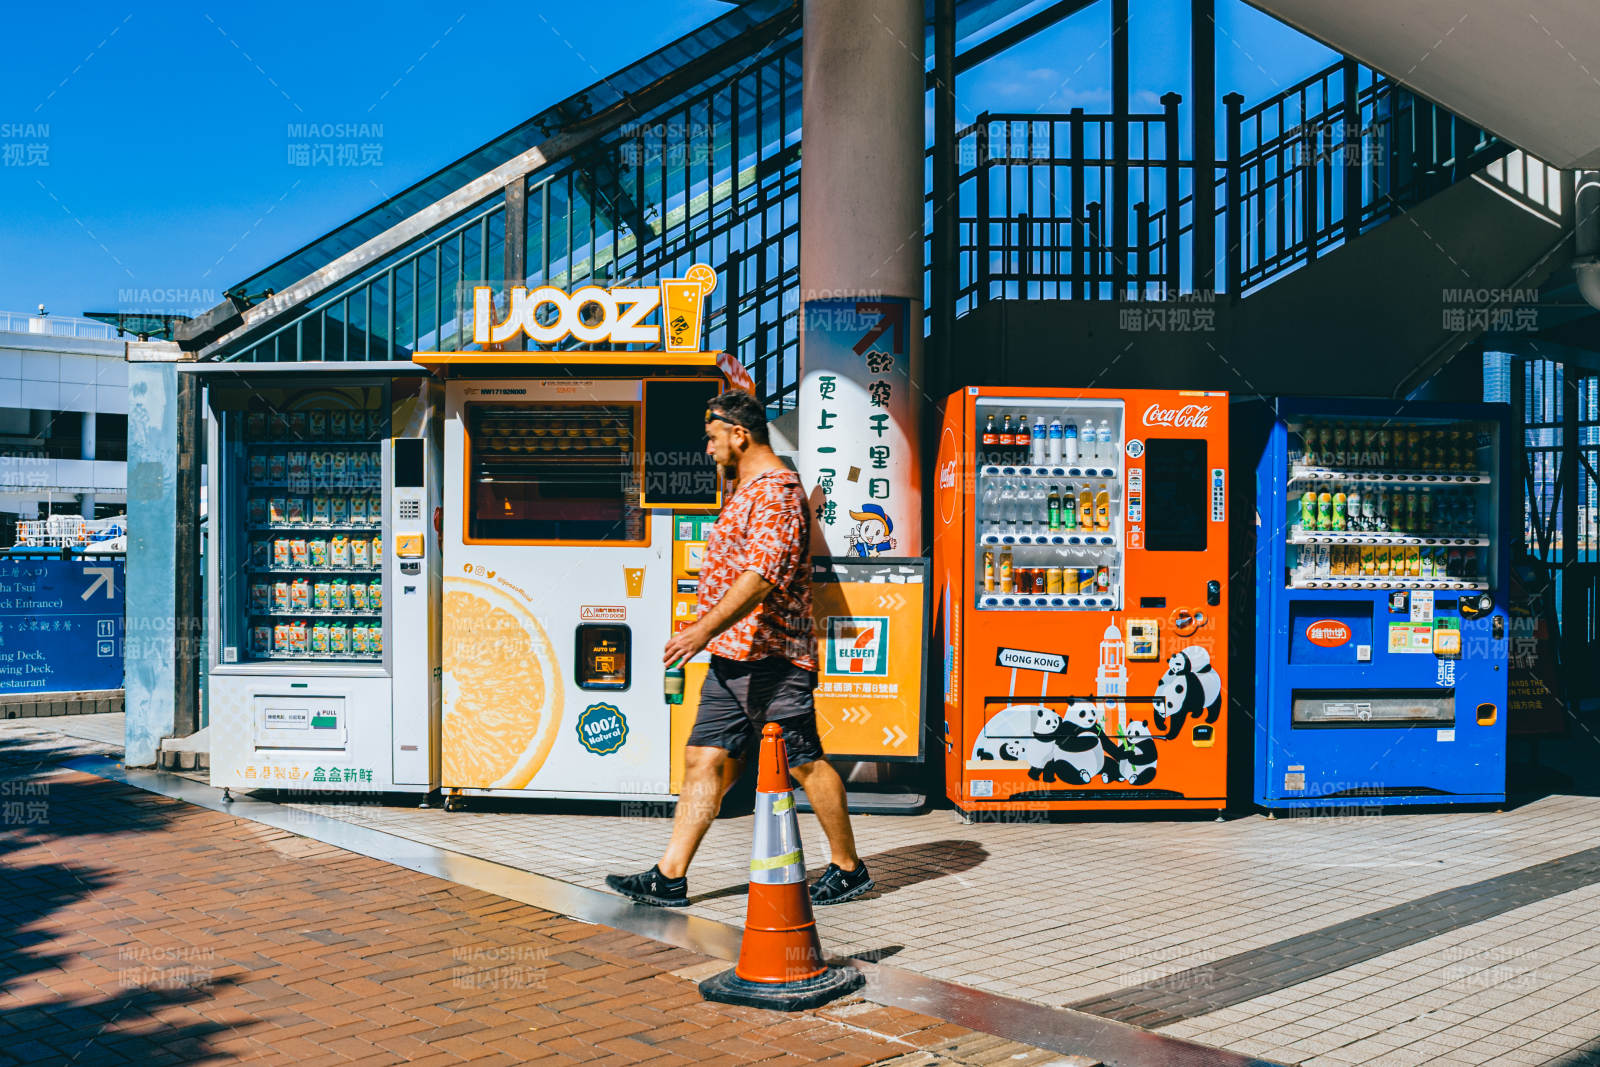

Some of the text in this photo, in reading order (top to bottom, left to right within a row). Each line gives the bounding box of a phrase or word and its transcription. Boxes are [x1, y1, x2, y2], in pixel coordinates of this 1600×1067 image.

[866, 351, 893, 499] 欲窮千里目
[15, 582, 36, 592] Tsui
[15, 599, 63, 609] Entrance)
[1005, 653, 1060, 668] HONG KONG
[0, 678, 46, 688] estaurant
[584, 715, 620, 737] 100%
[588, 728, 621, 745] Natural
[313, 766, 374, 783] 盒盒新鮮
